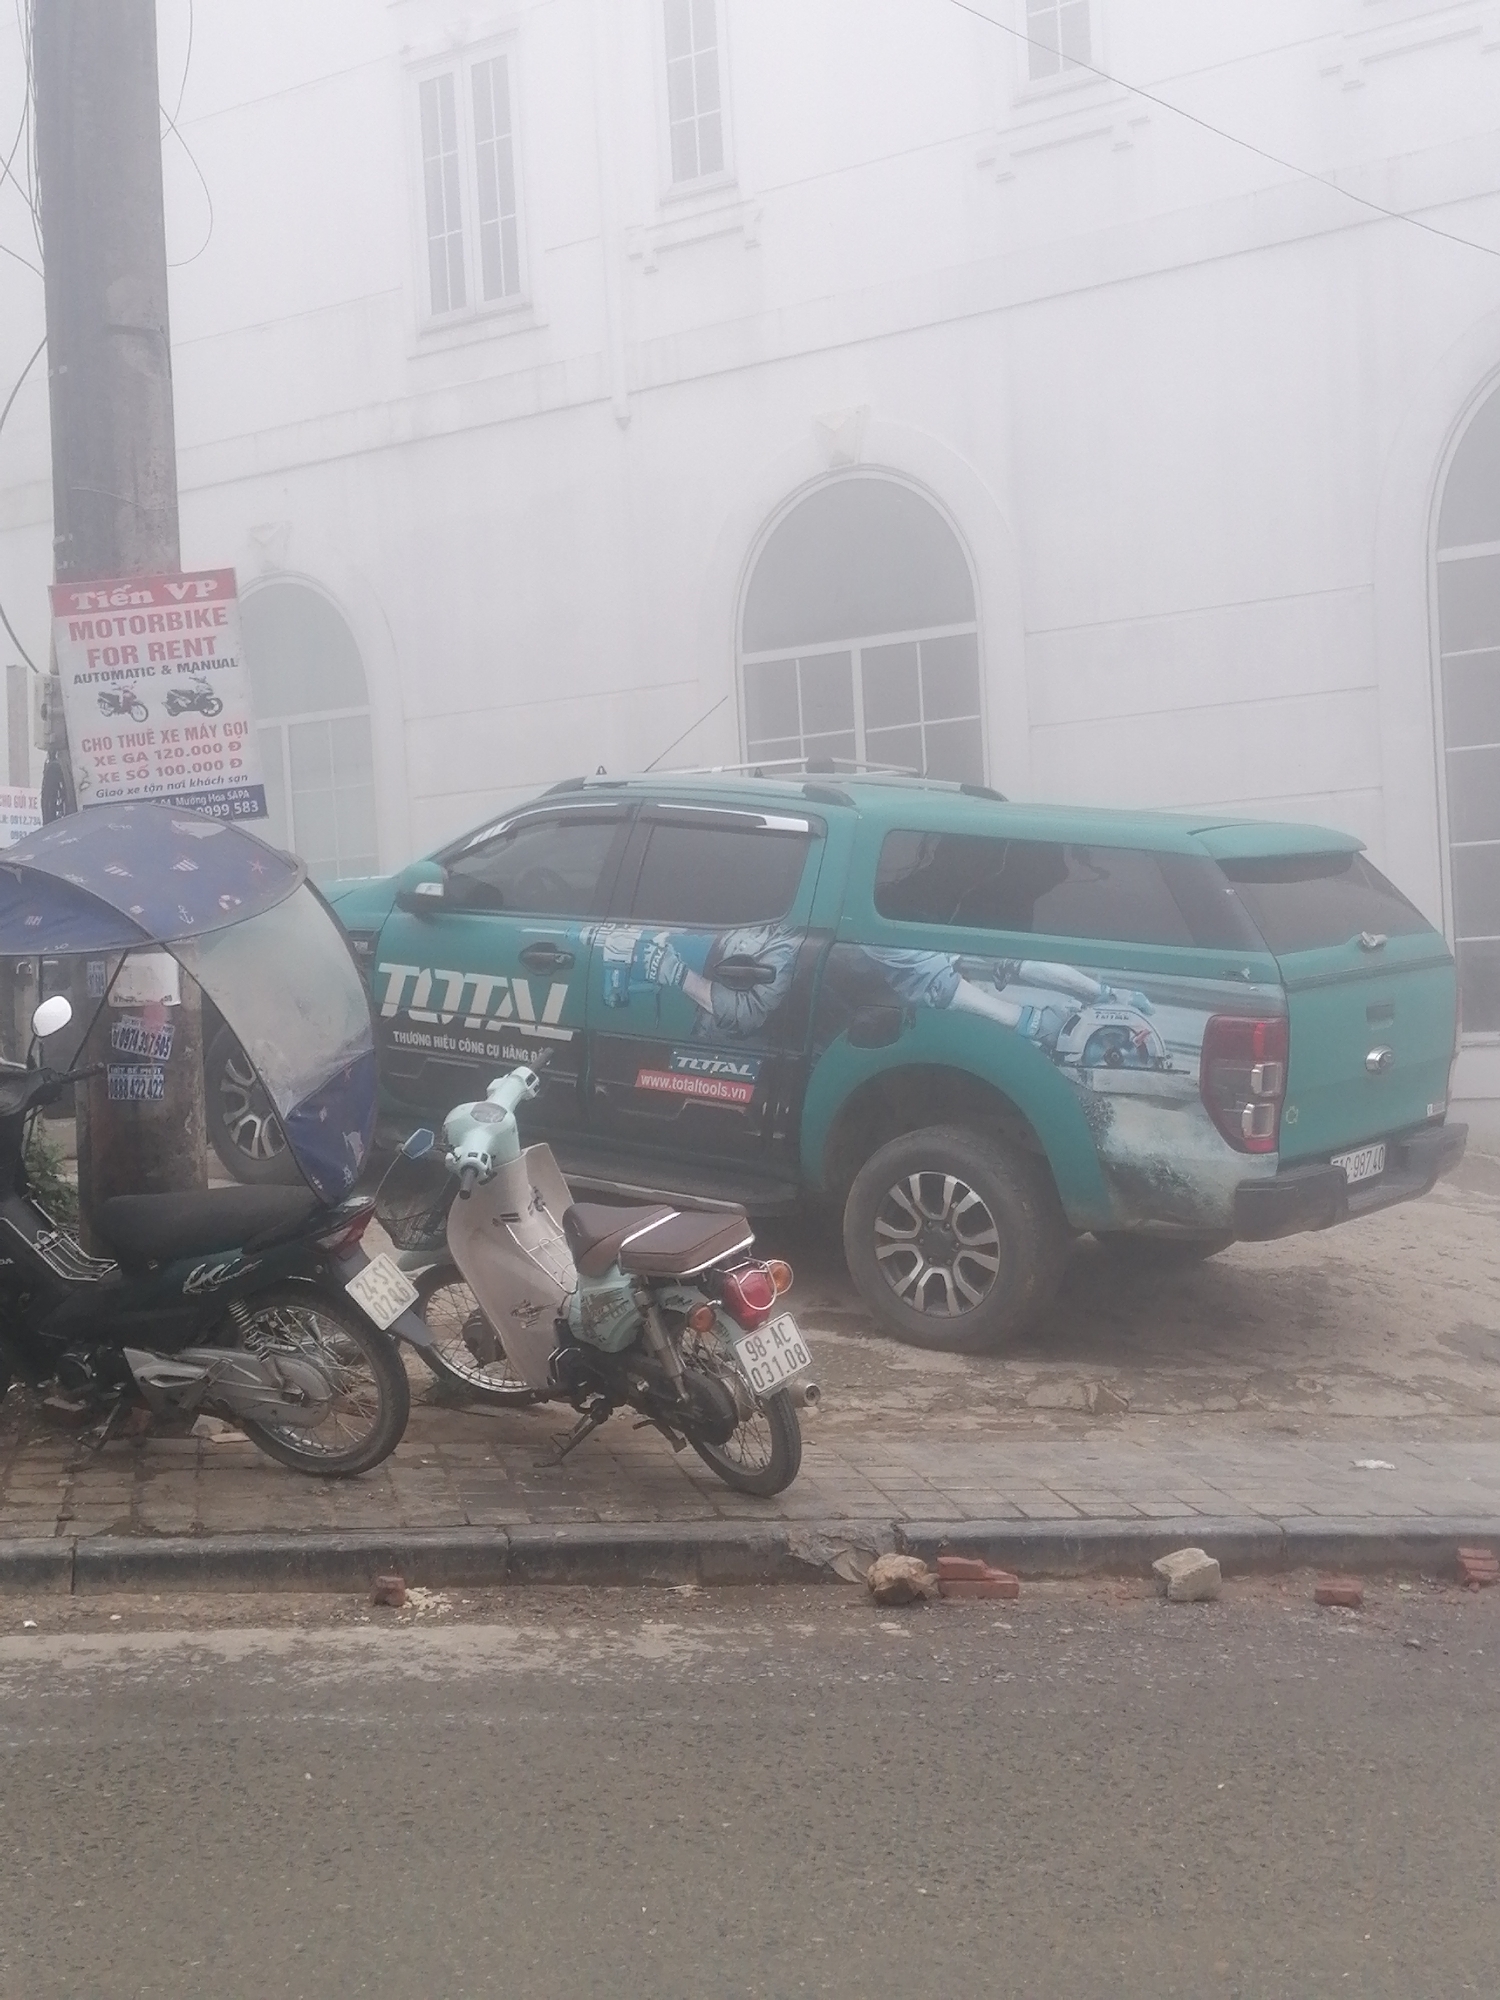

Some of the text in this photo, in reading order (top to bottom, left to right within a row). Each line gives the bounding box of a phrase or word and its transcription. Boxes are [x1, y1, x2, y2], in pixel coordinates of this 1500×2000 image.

[70, 579, 218, 610] Tiến VP
[68, 606, 228, 642] MOTORBIKE
[87, 636, 217, 669] FOR RENT
[73, 657, 238, 685] AUTOMATIC & MANUAL
[81, 736, 113, 753] CHO
[118, 728, 155, 749] THUÊ
[161, 729, 181, 744] XE
[185, 723, 217, 741] MÁY
[94, 755, 117, 767] XE
[122, 751, 149, 764] GA
[154, 743, 223, 760] 120.000
[98, 772, 121, 784] XE
[155, 759, 224, 777] 100.000
[96, 789, 124, 799] Giao
[127, 787, 140, 795] xe
[144, 783, 163, 795] tận
[189, 775, 224, 788] khách
[228, 773, 248, 784] sạn
[227, 789, 250, 801] SAPA
[234, 800, 259, 814] 583
[378, 963, 573, 1041] TOTAL
[676, 1056, 753, 1076] TOTAL
[641, 1073, 746, 1100] www.totaltools.vn
[744, 1321, 791, 1362] 98-AC
[751, 1343, 807, 1389] 031.08
